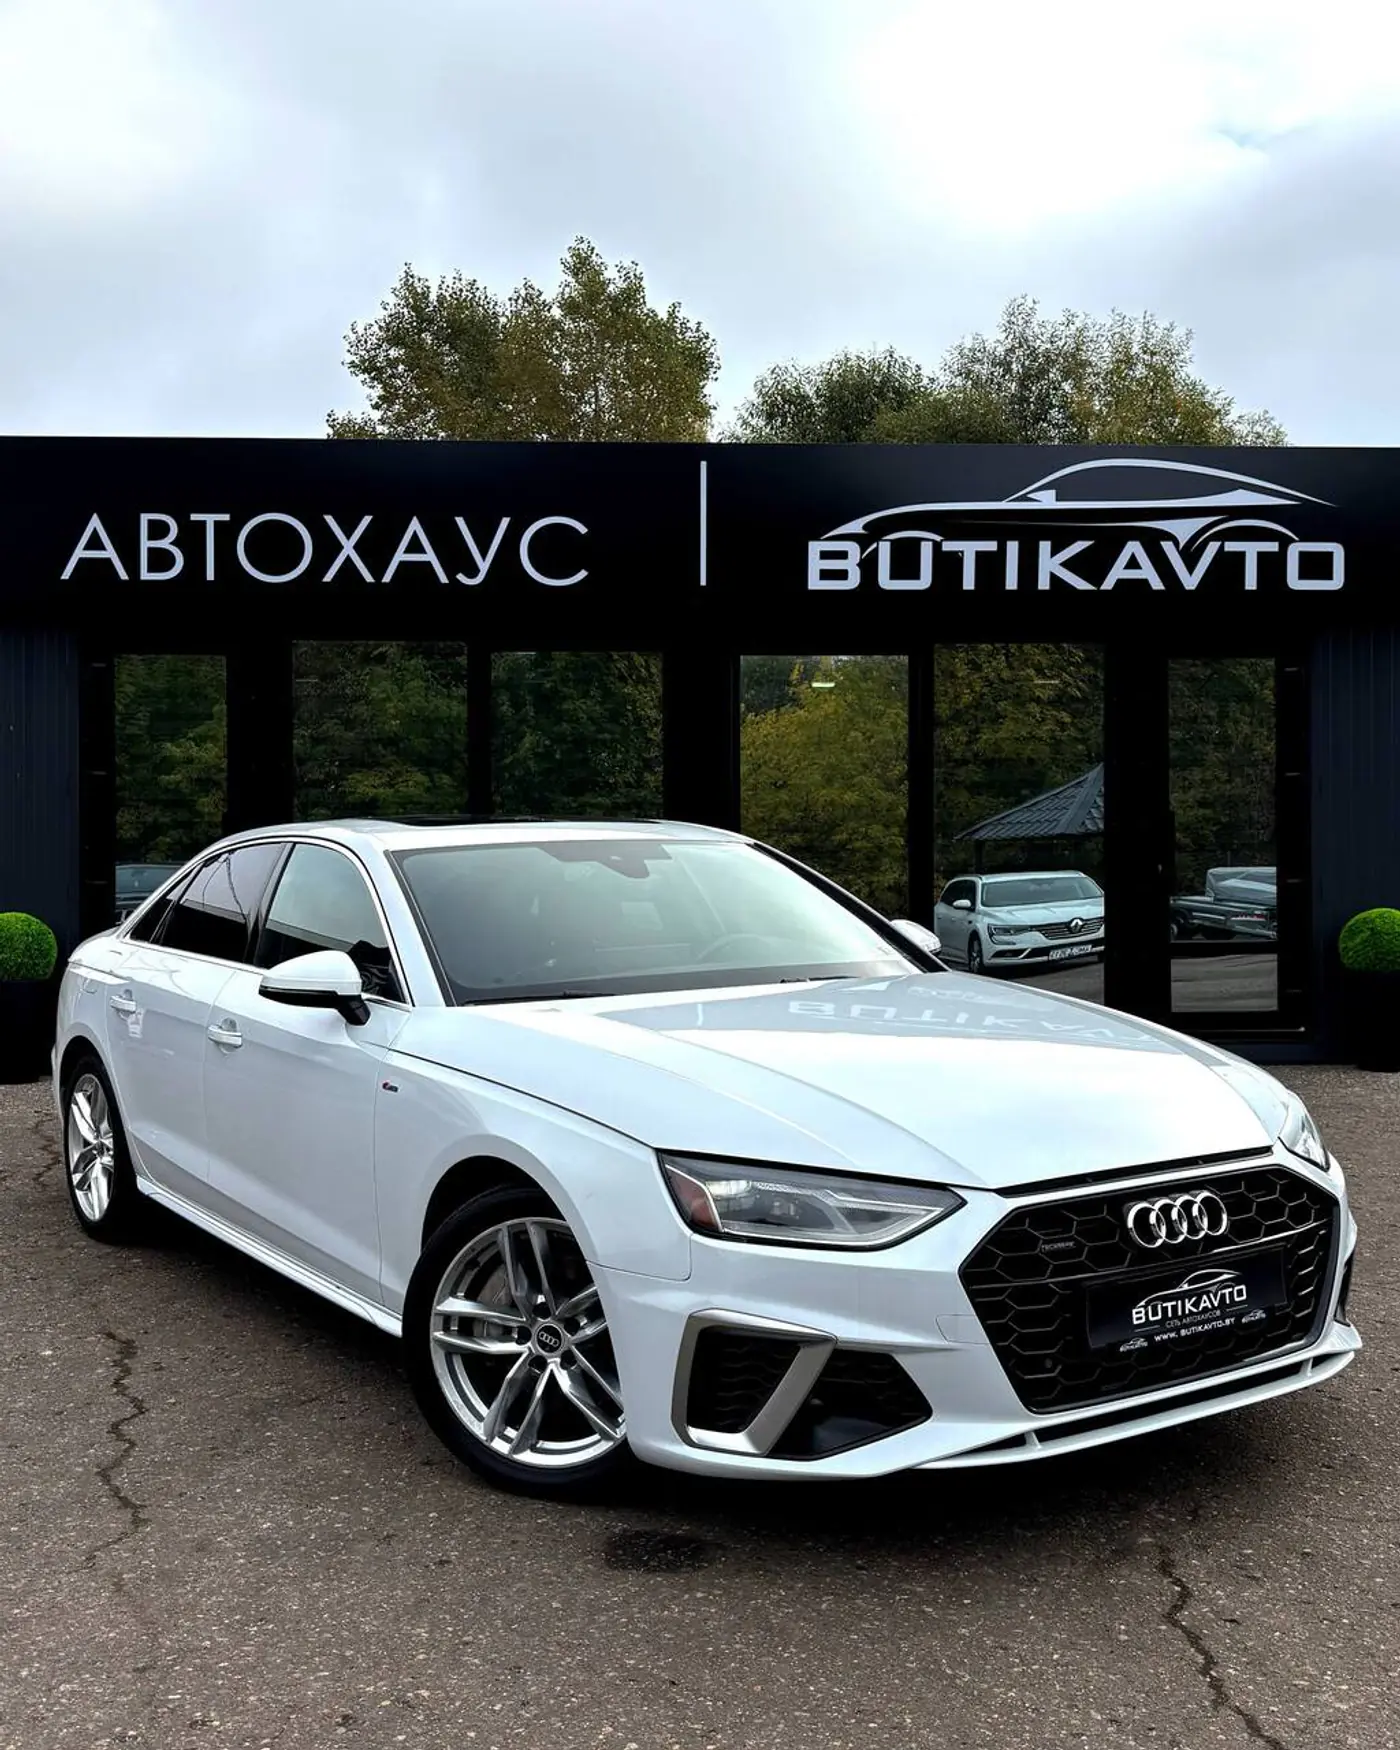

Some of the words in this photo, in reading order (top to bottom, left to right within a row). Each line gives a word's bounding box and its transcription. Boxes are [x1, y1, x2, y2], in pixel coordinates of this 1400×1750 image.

[60, 512, 589, 587] АВТОХАУС
[806, 540, 1346, 591] BUTIKAVTO
[1132, 1284, 1247, 1325] BUTIKAVTO
